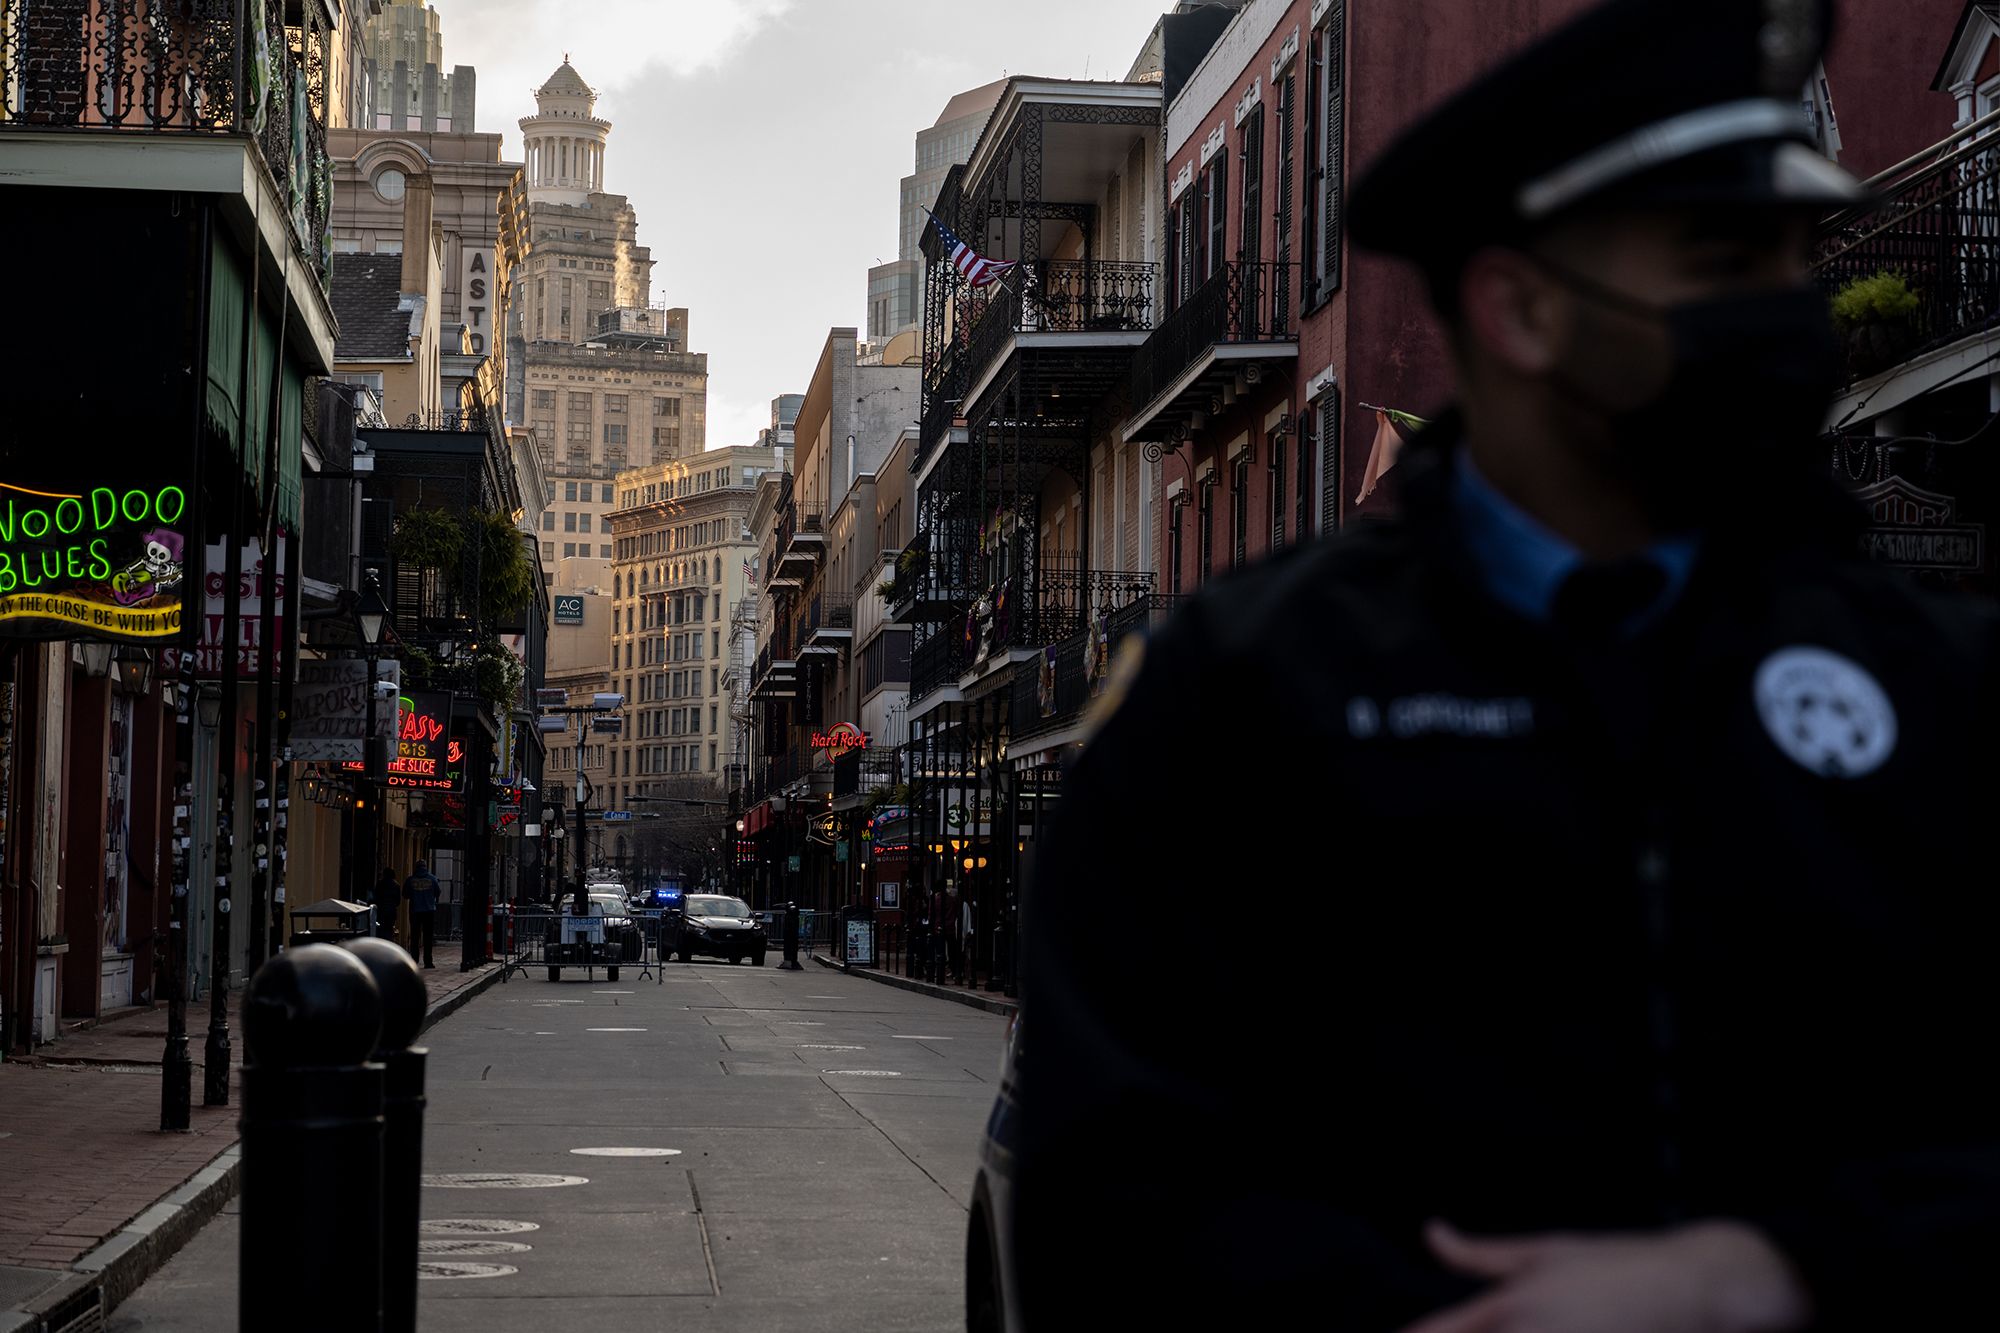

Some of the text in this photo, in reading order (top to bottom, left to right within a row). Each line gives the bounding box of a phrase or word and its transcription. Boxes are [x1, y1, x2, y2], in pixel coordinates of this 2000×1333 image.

[0, 538, 111, 592] BLUES
[19, 597, 44, 612] THE
[45, 598, 88, 621] CURSE
[93, 608, 113, 627] BE
[117, 612, 156, 631] WITH
[558, 599, 580, 611] AC
[811, 731, 867, 751] Hard Rock
[407, 759, 435, 775] SLICE
